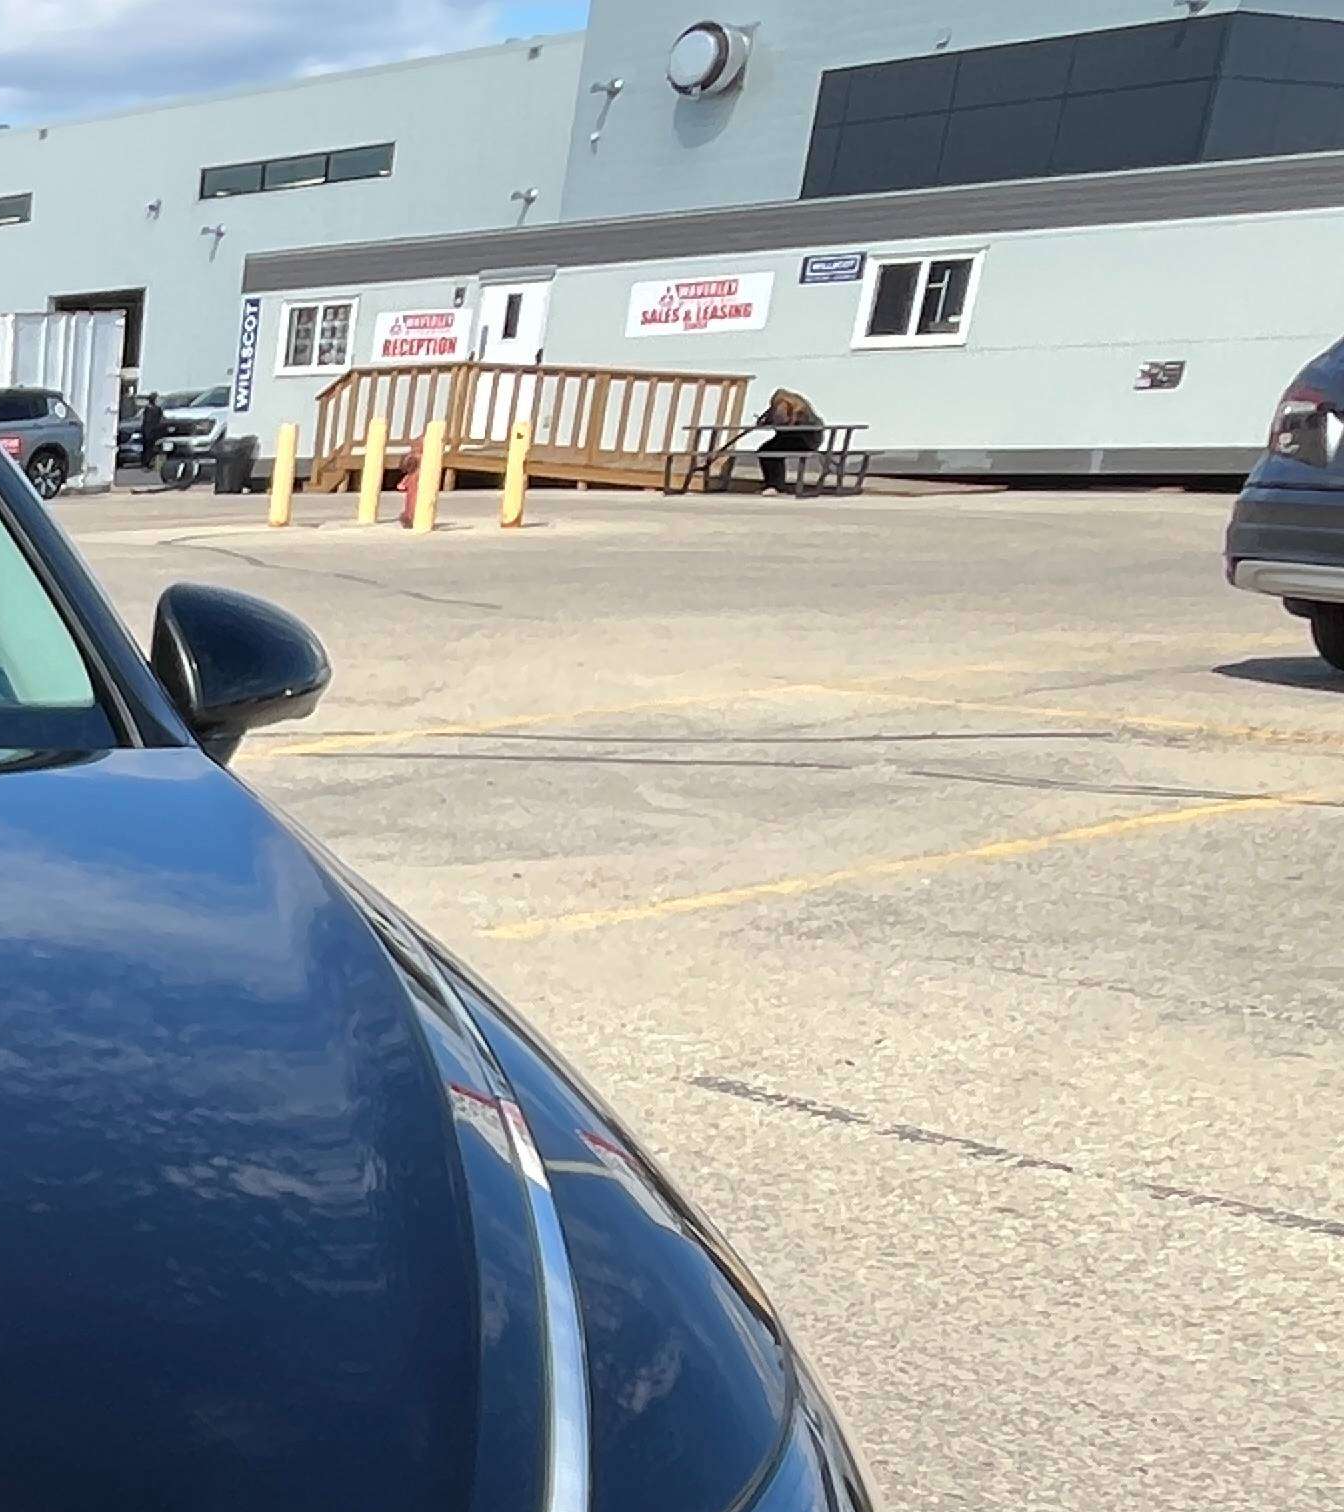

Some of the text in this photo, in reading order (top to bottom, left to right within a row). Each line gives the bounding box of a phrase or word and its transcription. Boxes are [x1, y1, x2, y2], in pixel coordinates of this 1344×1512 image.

[641, 307, 679, 324] SALES
[696, 303, 752, 320] LEASING
[236, 302, 258, 409] WILLSCOT
[382, 336, 457, 357] RECEPTION
